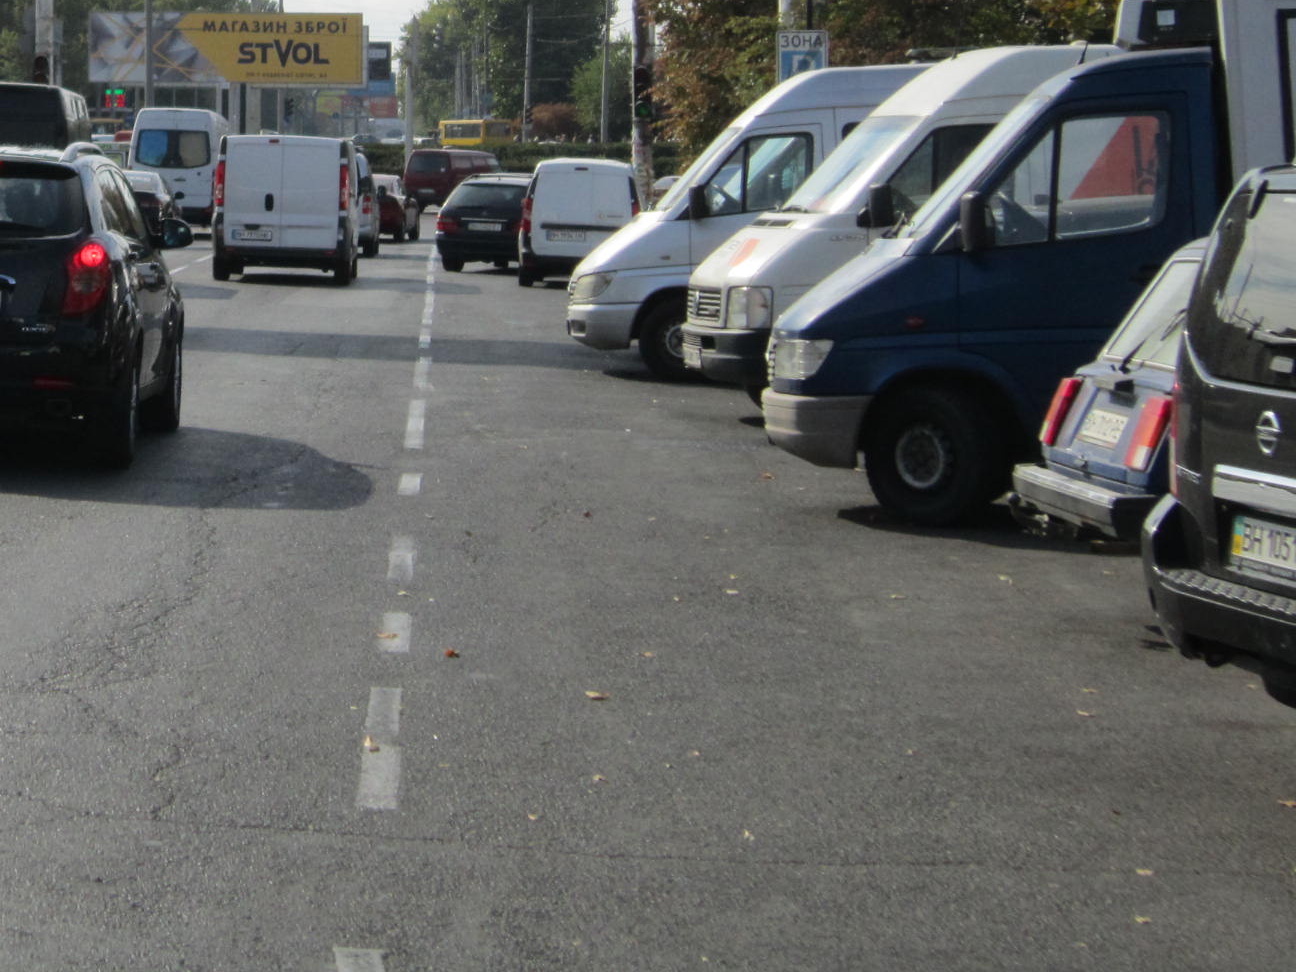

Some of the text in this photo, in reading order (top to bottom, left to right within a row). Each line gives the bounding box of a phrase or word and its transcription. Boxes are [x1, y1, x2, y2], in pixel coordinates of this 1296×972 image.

[203, 18, 347, 34] МАГАЗИН ЗБРОЇ
[781, 35, 823, 47] ЗОНА
[237, 39, 330, 67] STVOL
[1243, 523, 1296, 561] BH 105
